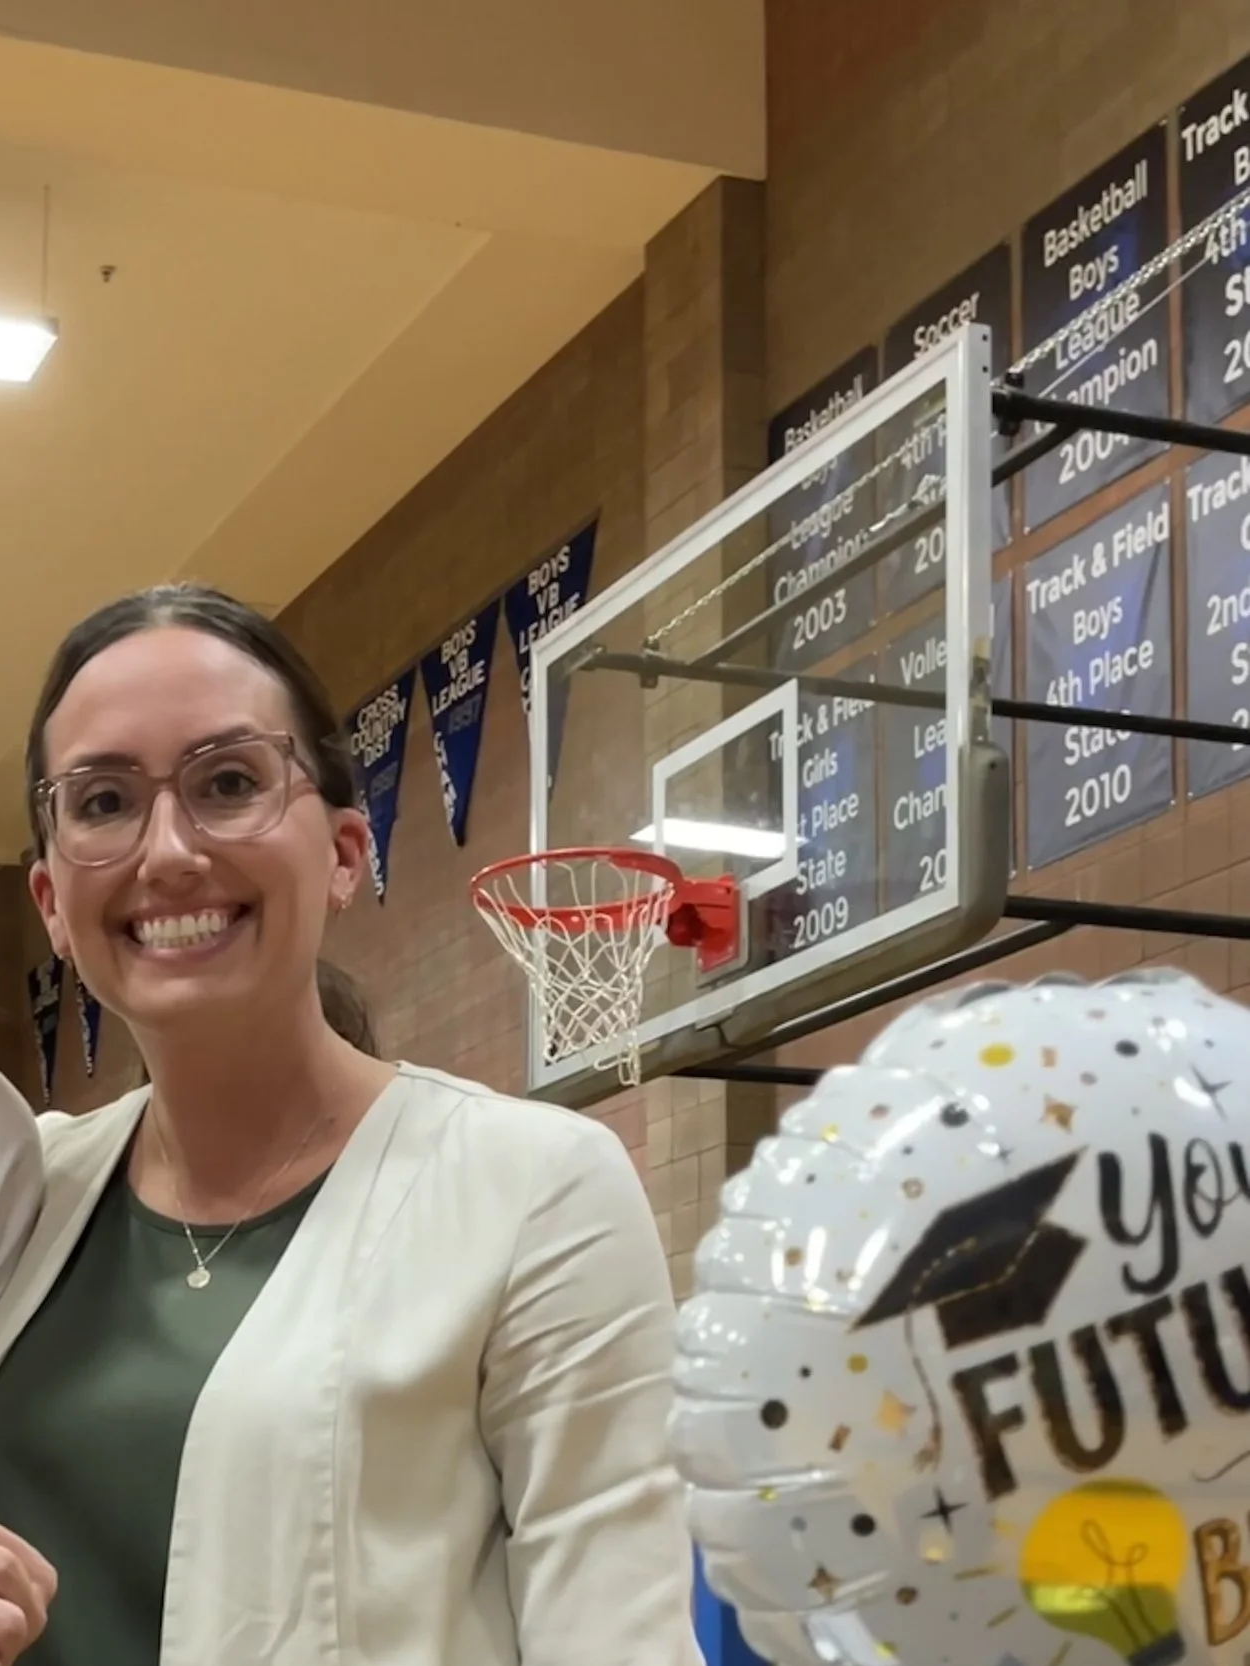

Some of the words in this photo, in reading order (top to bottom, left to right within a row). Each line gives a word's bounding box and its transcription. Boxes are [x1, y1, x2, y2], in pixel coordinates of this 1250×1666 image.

[1181, 88, 1249, 162] Track
[1043, 158, 1148, 268] Basketball
[1069, 244, 1119, 300] Boys
[1055, 290, 1140, 370] League
[527, 545, 571, 597] BOYS
[1026, 554, 1087, 614] Track
[1090, 541, 1108, 578] &
[1112, 501, 1170, 568] Field
[441, 619, 477, 665] BOYS
[792, 587, 847, 651] 2003
[1072, 596, 1123, 645] Boys
[432, 659, 486, 718] LEAGUE
[1088, 639, 1154, 697] Place
[768, 711, 813, 762] Trck
[802, 747, 839, 789] Girls
[1064, 763, 1132, 828] 2010
[811, 792, 860, 838] Place
[795, 849, 846, 896] State
[792, 895, 849, 949] 2009
[952, 1263, 1250, 1503] FUTU
